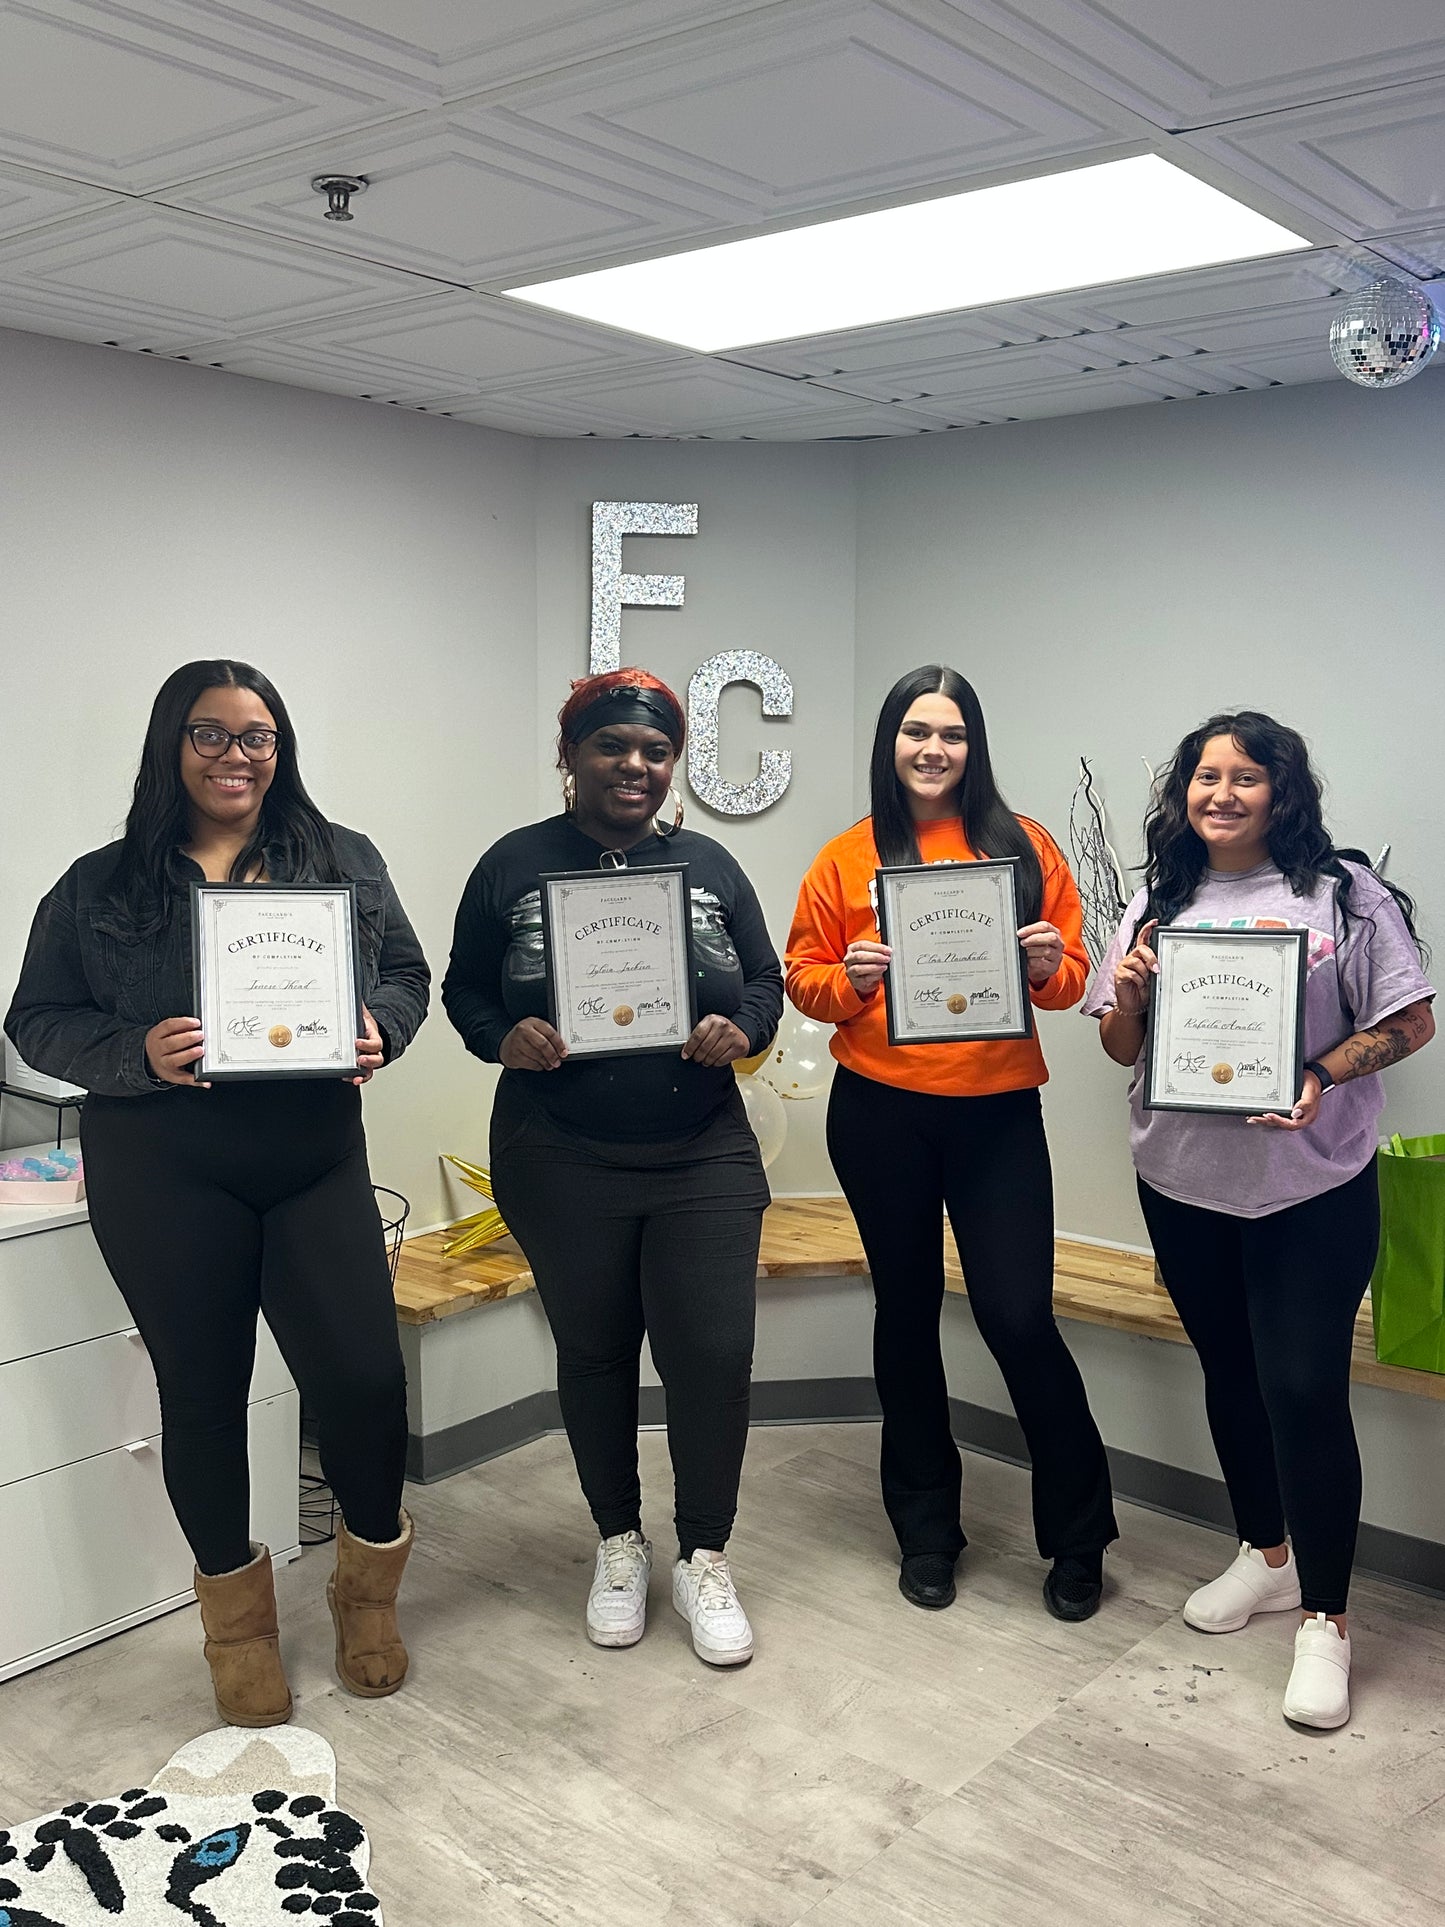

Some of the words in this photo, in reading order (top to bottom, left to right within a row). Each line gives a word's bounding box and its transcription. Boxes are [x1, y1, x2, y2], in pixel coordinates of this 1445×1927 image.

[590, 501, 698, 675] F
[687, 649, 794, 816] C
[574, 916, 662, 940] CERTIFICATE
[909, 908, 994, 932] CERTIFICATE
[227, 932, 326, 954] CERTIFICATE
[619, 961, 651, 973] Jackson
[1181, 974, 1274, 998] CERTIFICATE
